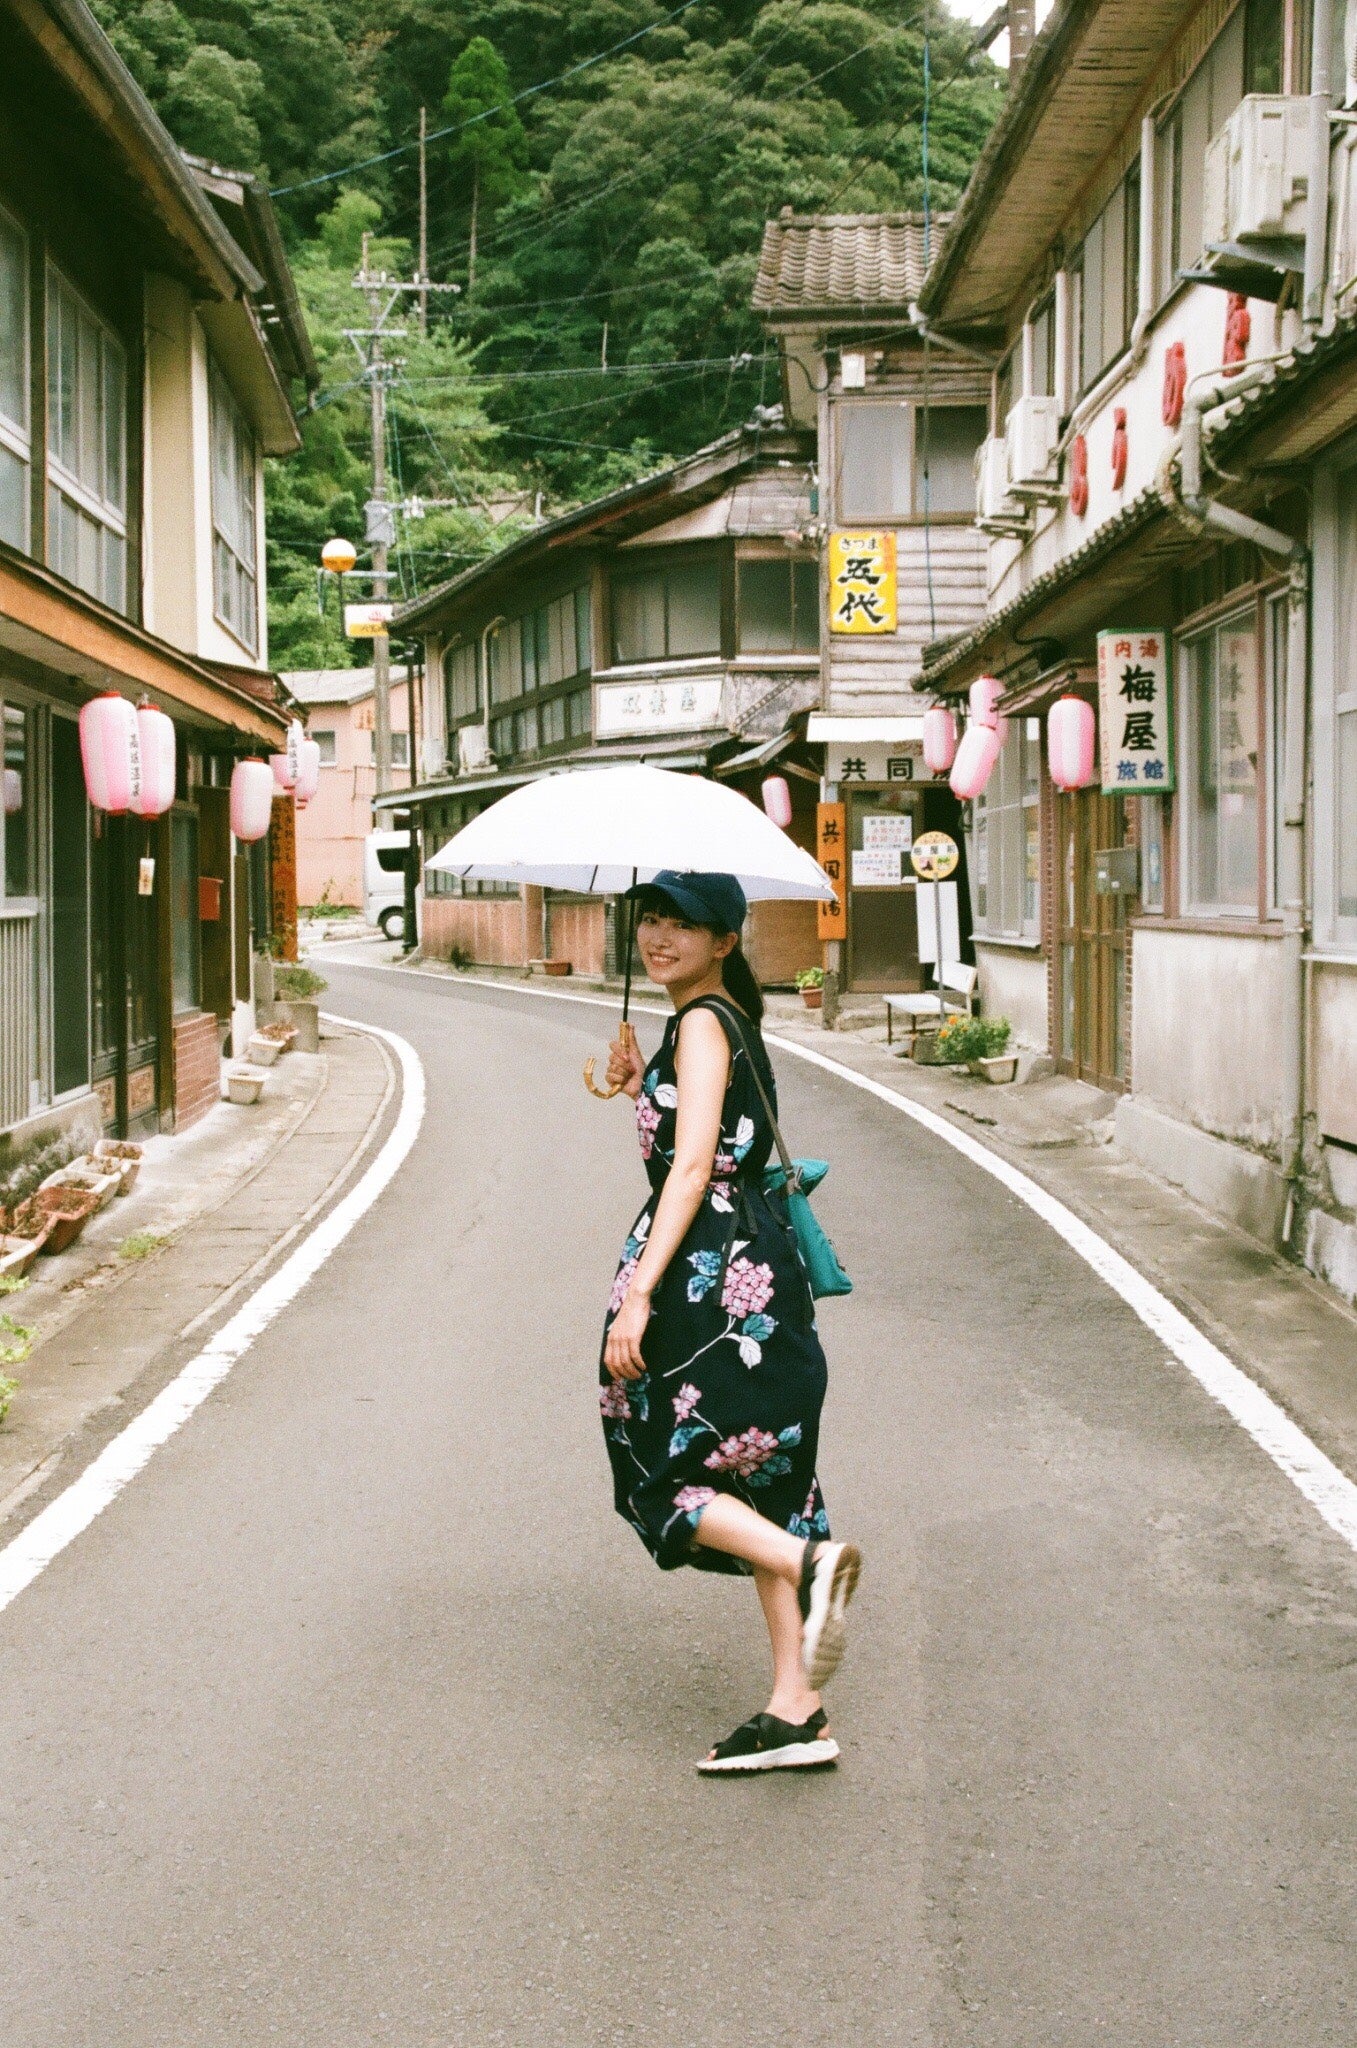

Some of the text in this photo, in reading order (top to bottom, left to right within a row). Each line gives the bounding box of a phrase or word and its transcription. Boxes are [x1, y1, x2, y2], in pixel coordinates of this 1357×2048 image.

[841, 538, 877, 550] さつま
[838, 558, 884, 624] 五代
[1114, 638, 1160, 660] 内湯
[1119, 663, 1158, 752] 梅屋
[1116, 758, 1165, 781] 旅館
